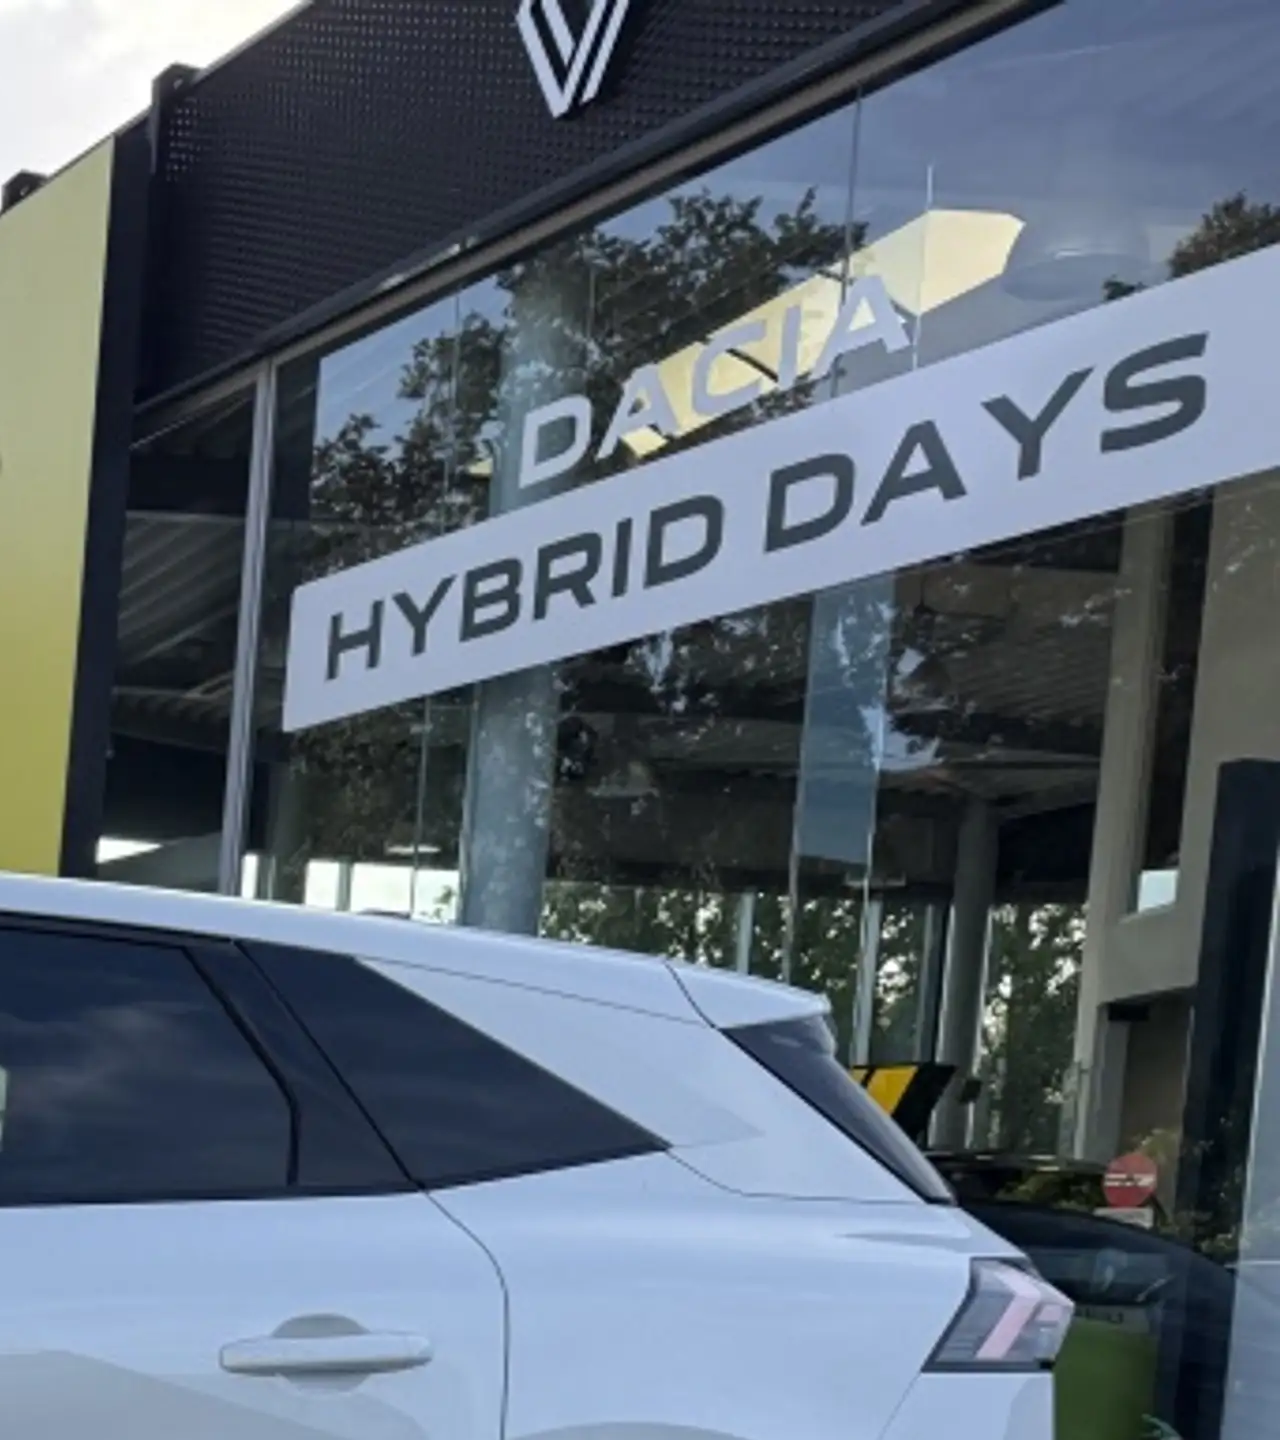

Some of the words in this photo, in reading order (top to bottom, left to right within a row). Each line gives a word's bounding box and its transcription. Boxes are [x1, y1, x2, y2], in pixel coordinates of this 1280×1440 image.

[323, 493, 726, 682] HYBRID
[763, 331, 1210, 552] DAYS
[518, 275, 916, 489] DACIA
